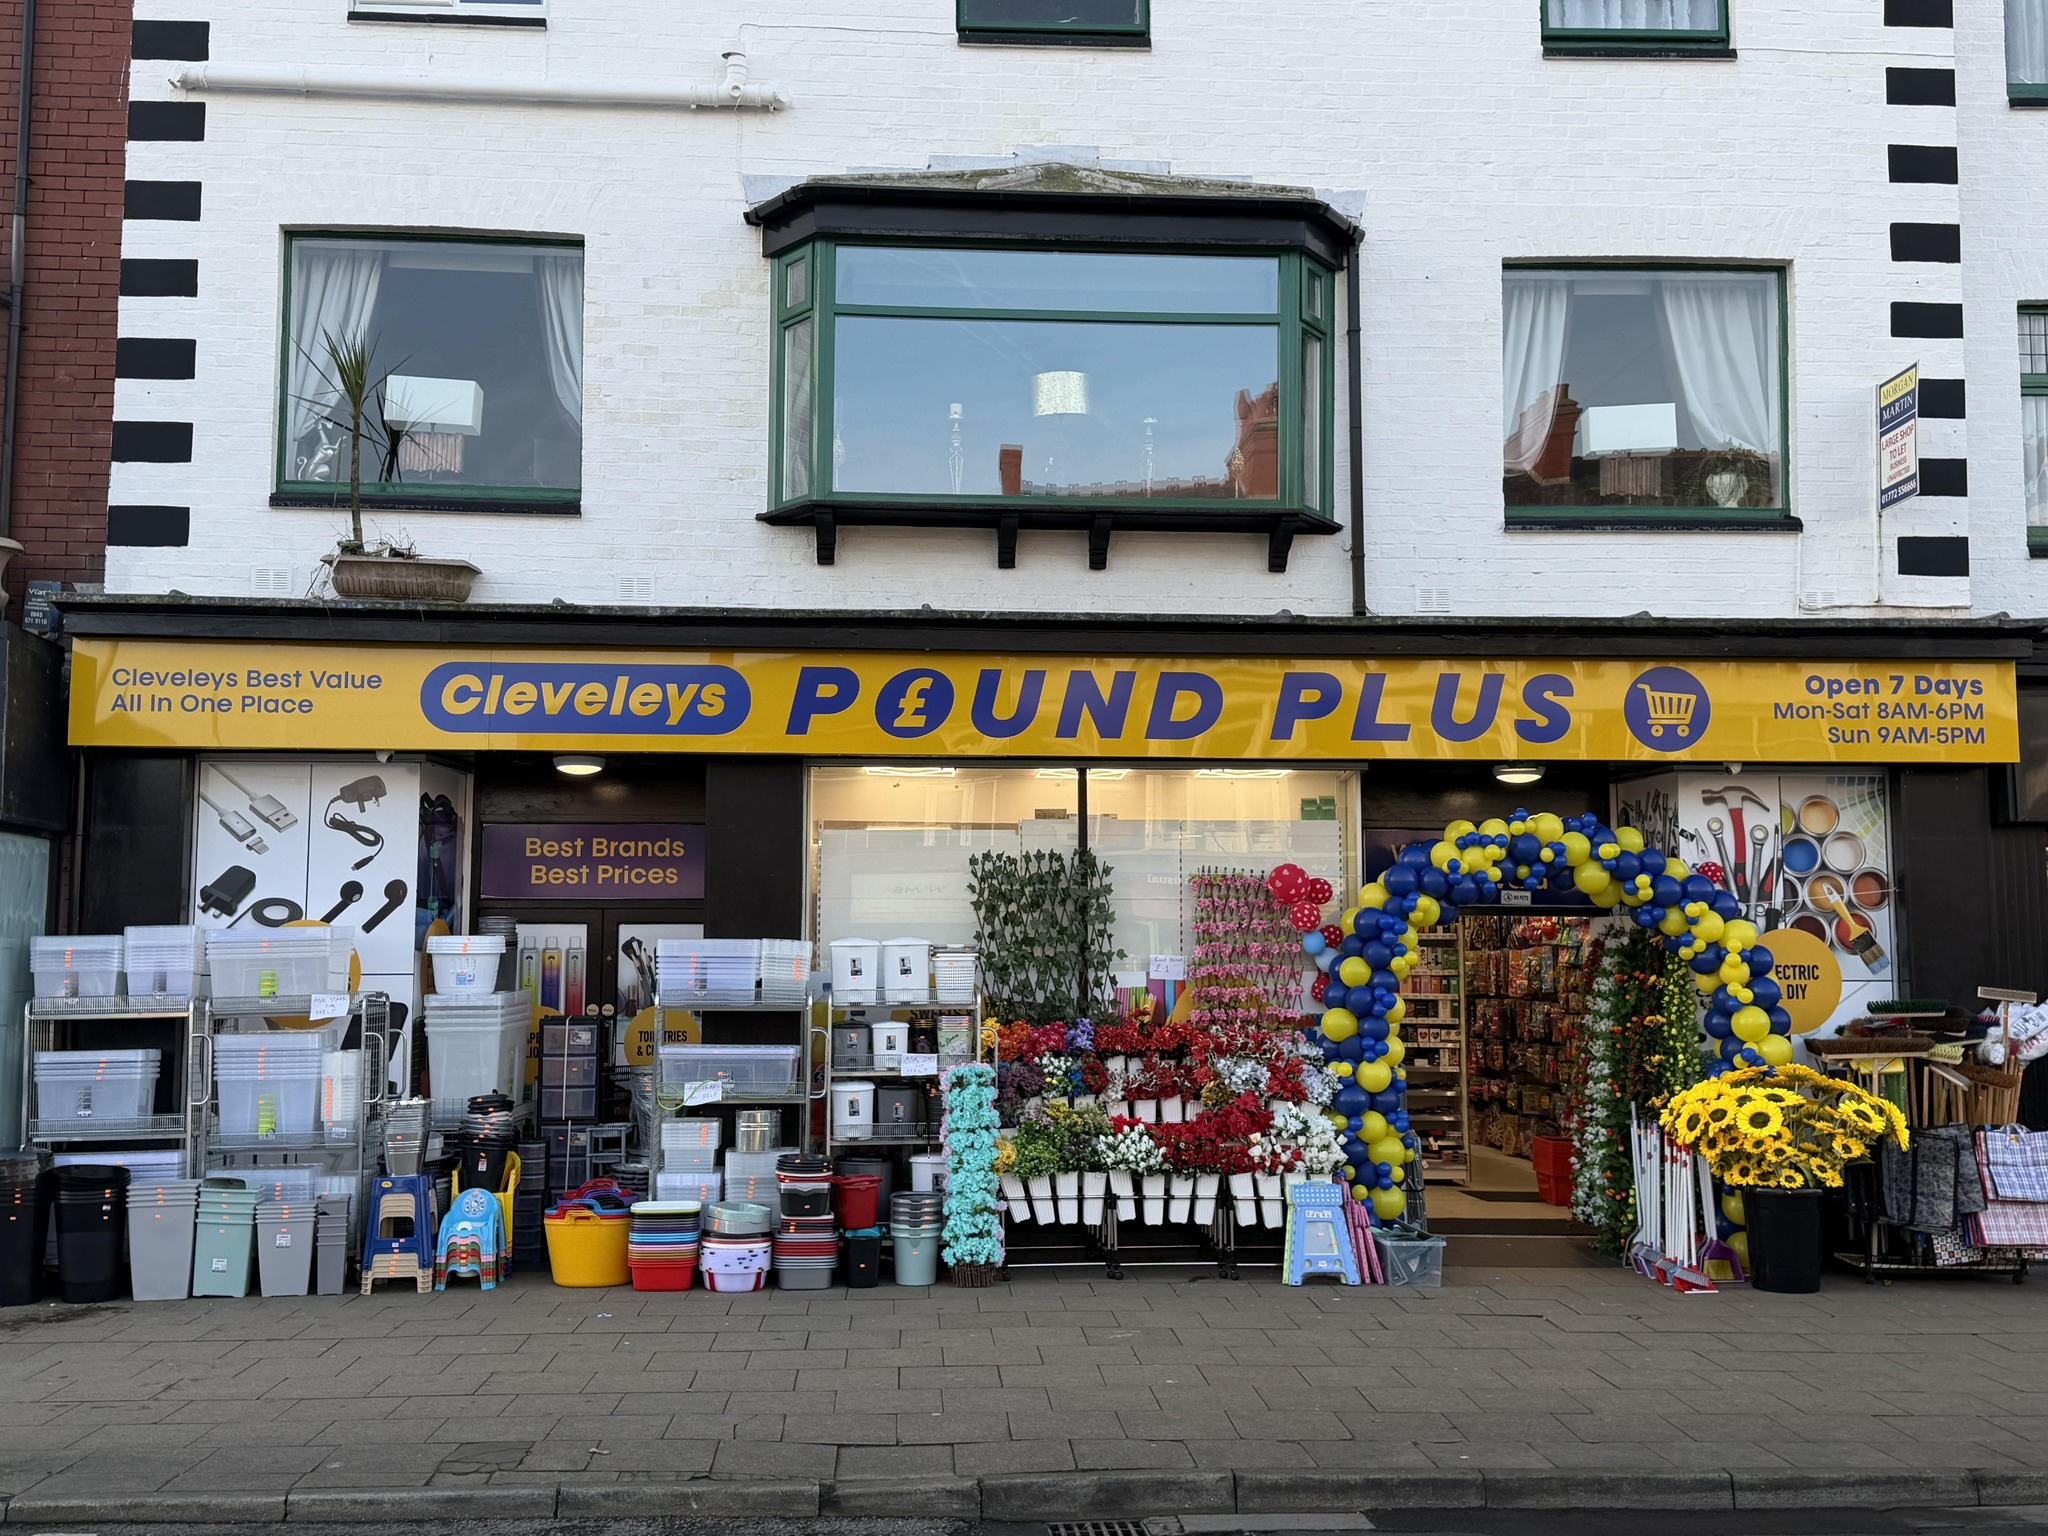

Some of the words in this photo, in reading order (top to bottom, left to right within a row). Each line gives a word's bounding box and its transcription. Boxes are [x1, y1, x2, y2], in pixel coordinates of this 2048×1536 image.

[1882, 372, 1914, 402] MORGAN
[1882, 393, 1913, 422] MARTIN
[1882, 434, 1899, 451] LARGE
[1900, 425, 1914, 442] SHOP
[1889, 450, 1897, 461] TO
[1898, 442, 1907, 457] LET
[1889, 458, 1907, 471] BUSINESS
[1881, 487, 1897, 504] 01772
[112, 668, 238, 691] Cleveleys
[246, 669, 302, 688] Best
[310, 670, 383, 689] Value
[1805, 675, 1880, 699] Open
[1889, 675, 1904, 695] 7
[1914, 675, 1984, 700] Days
[110, 694, 142, 712] All
[150, 694, 172, 712] In
[180, 694, 232, 713] One
[241, 695, 314, 714] Place
[440, 674, 727, 726] Cleveleys
[1269, 671, 1575, 744] PLUS
[1773, 702, 1870, 720] Mon-Sat
[1876, 702, 1984, 720] 8AM-6PM
[1828, 726, 1870, 744] Sun
[1877, 726, 1985, 744] 9AM-5PM
[525, 837, 584, 857] Best
[592, 837, 685, 857] Brands
[530, 864, 590, 884] Best
[597, 864, 679, 884] Prices
[1775, 964, 1820, 980] ECTRIC
[1786, 984, 1808, 1000] DIY
[637, 1047, 644, 1056] &
